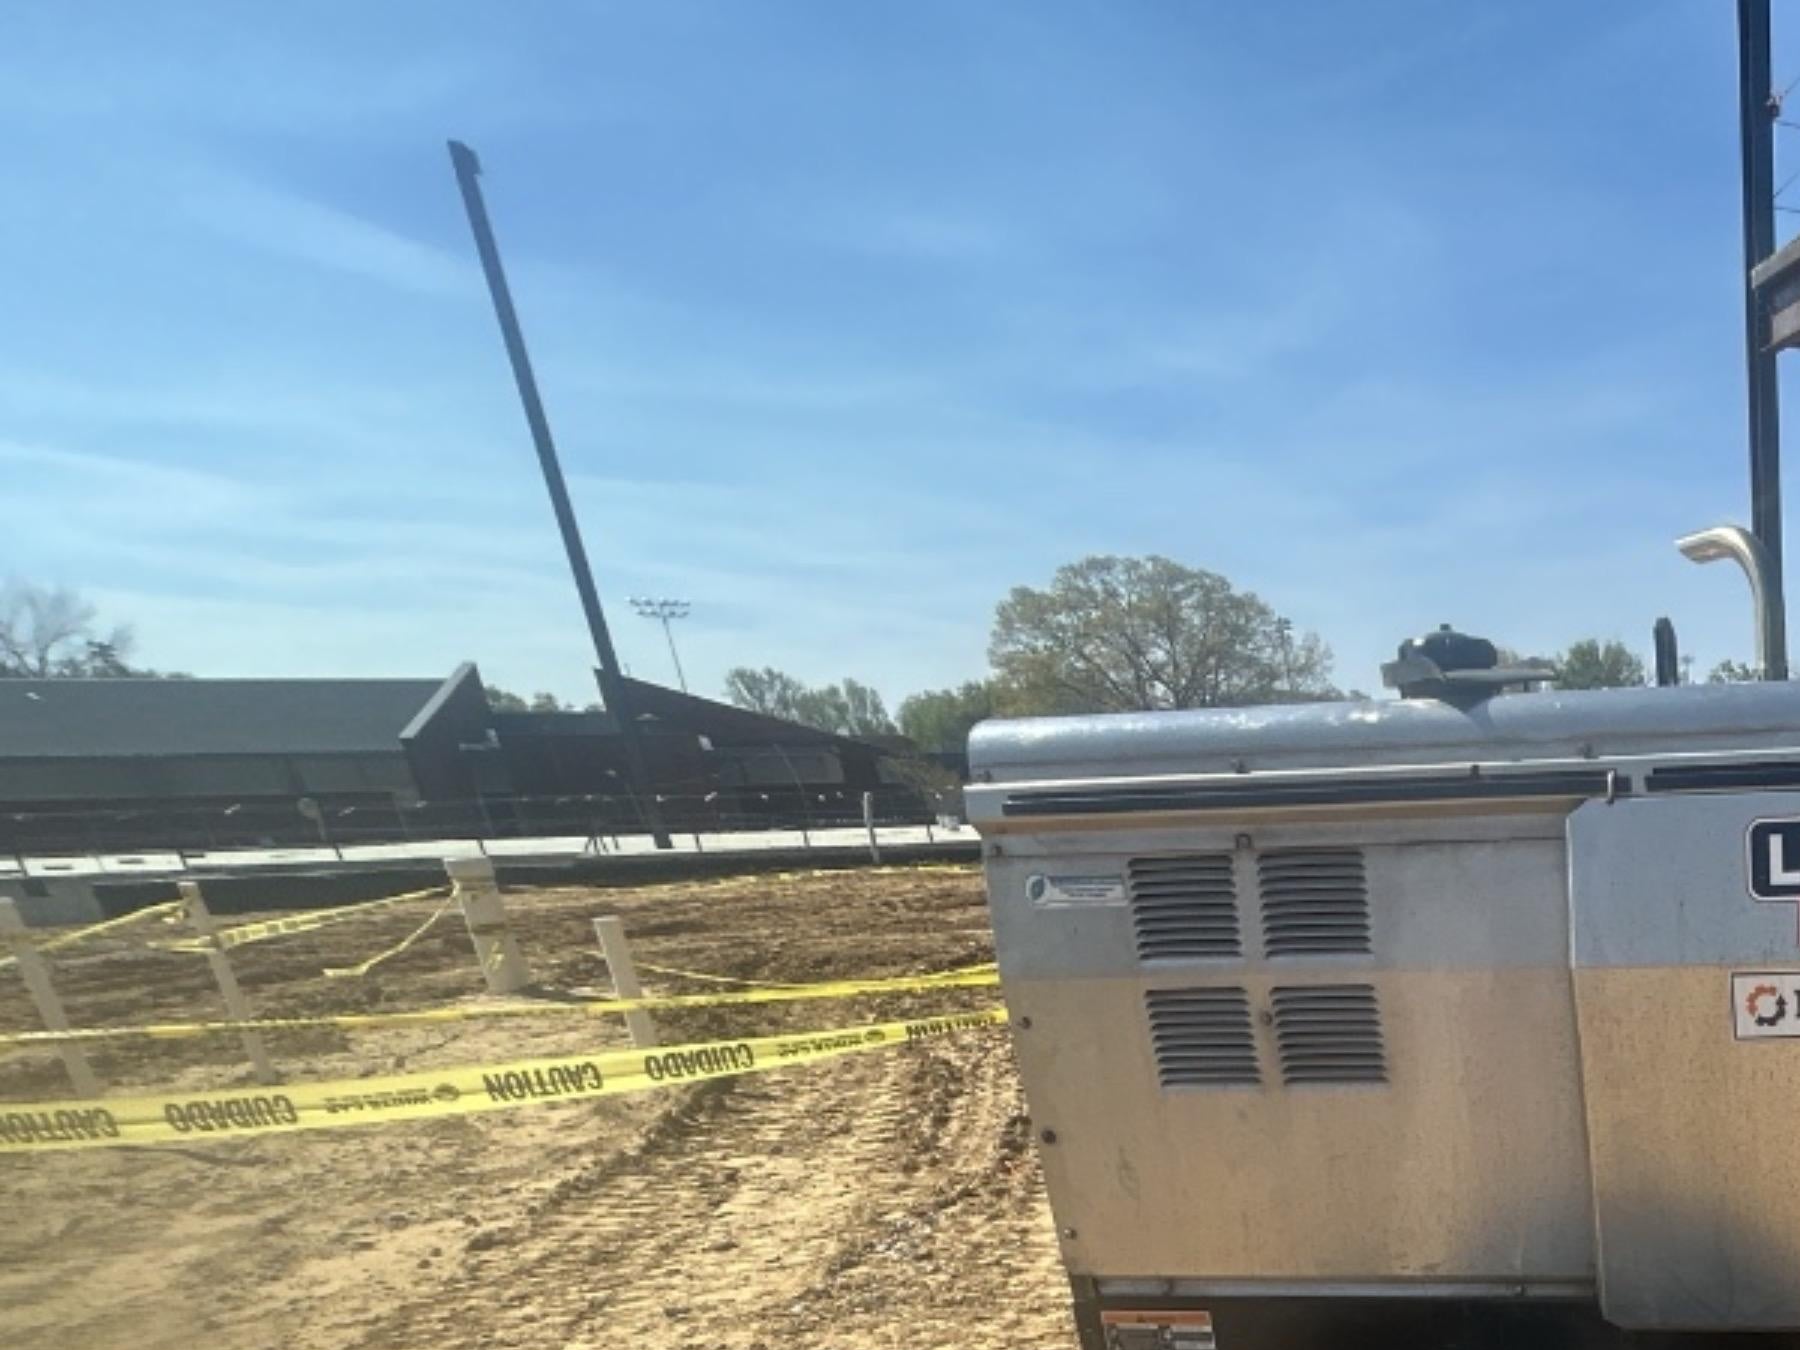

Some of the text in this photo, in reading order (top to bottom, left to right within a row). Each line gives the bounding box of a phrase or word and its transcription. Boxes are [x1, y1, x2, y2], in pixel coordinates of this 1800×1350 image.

[482, 1061, 603, 1101] CAUTION
[645, 1043, 754, 1081] CUIDADO
[164, 1095, 298, 1132] CUIDADO
